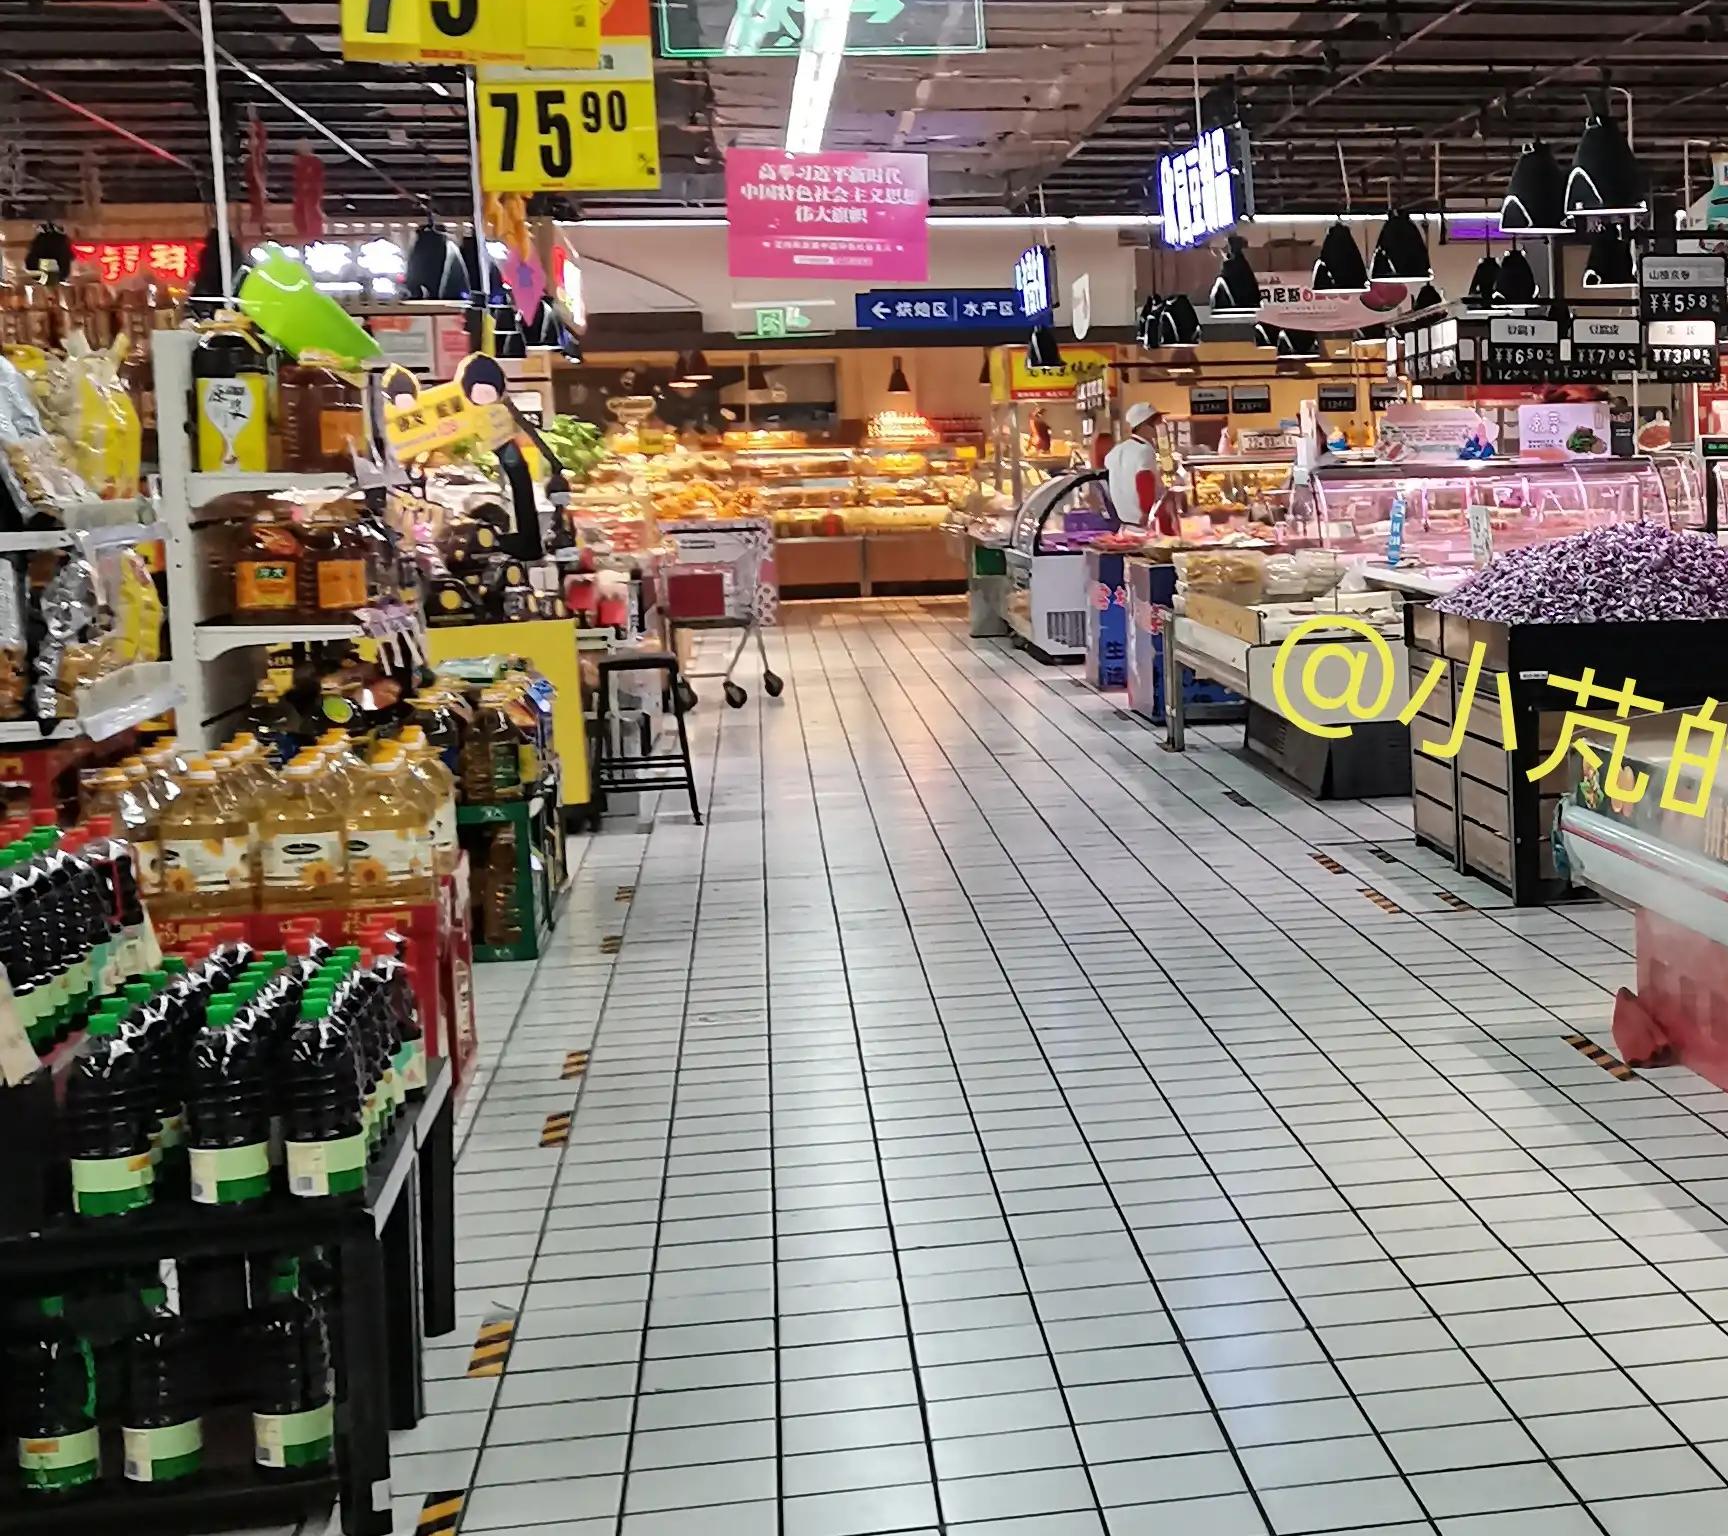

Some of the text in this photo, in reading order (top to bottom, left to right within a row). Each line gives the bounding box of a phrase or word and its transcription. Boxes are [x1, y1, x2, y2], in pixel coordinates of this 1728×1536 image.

[740, 182, 919, 206] 中国特色社会主义思想
[962, 301, 1014, 318] 水产区
